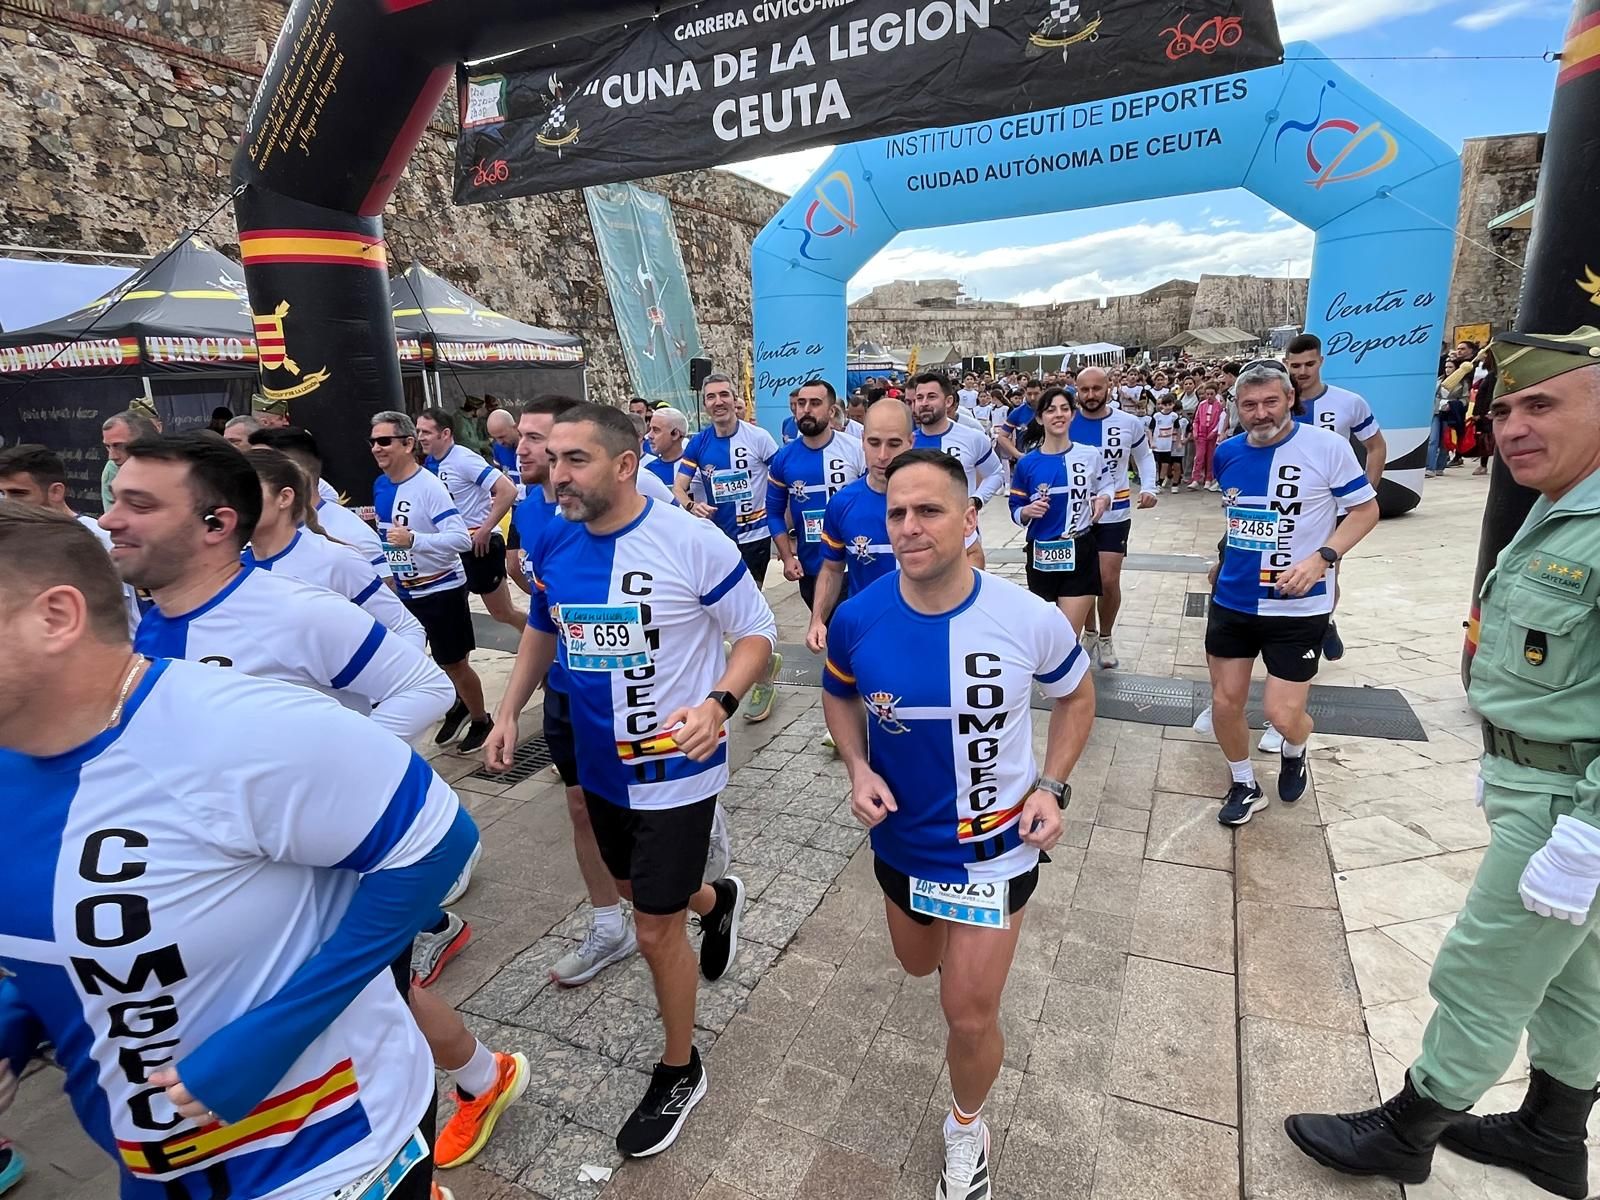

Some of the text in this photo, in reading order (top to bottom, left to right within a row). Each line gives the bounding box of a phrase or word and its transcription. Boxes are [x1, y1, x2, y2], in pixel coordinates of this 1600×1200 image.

[674, 0, 857, 41] CARRERA CÍVICO-
[583, 59, 702, 109] "CUNA
[713, 47, 758, 88] DE
[769, 35, 816, 74] LA
[829, 0, 1004, 60] LEGION
[271, 94, 281, 113] sin
[279, 140, 288, 152] la
[284, 99, 307, 141] distancia
[304, 81, 314, 99] con
[311, 32, 336, 71] enemigo
[712, 78, 851, 142] CEUTA
[885, 78, 1249, 160] INSTITUTO CEUTÍ DE DEPORTES
[906, 127, 1222, 192] CIUDAD AUTÓNOMA DE CEUTA
[1325, 289, 1437, 322] Ceuta es
[21, 338, 123, 370] DEPORTIVO
[145, 336, 244, 362] TERCIO
[435, 342, 488, 361] TERCIO
[756, 341, 825, 363] Ceuta es
[1326, 324, 1434, 365] Deporte
[758, 367, 825, 397] Deporte
[725, 479, 748, 491] 1349
[1241, 520, 1273, 537] 2485
[385, 551, 408, 562] 1263
[1044, 548, 1071, 561] 2088
[1540, 572, 1581, 589] CAYETANO
[593, 624, 630, 647] 659
[958, 652, 1009, 862] COMGECEU
